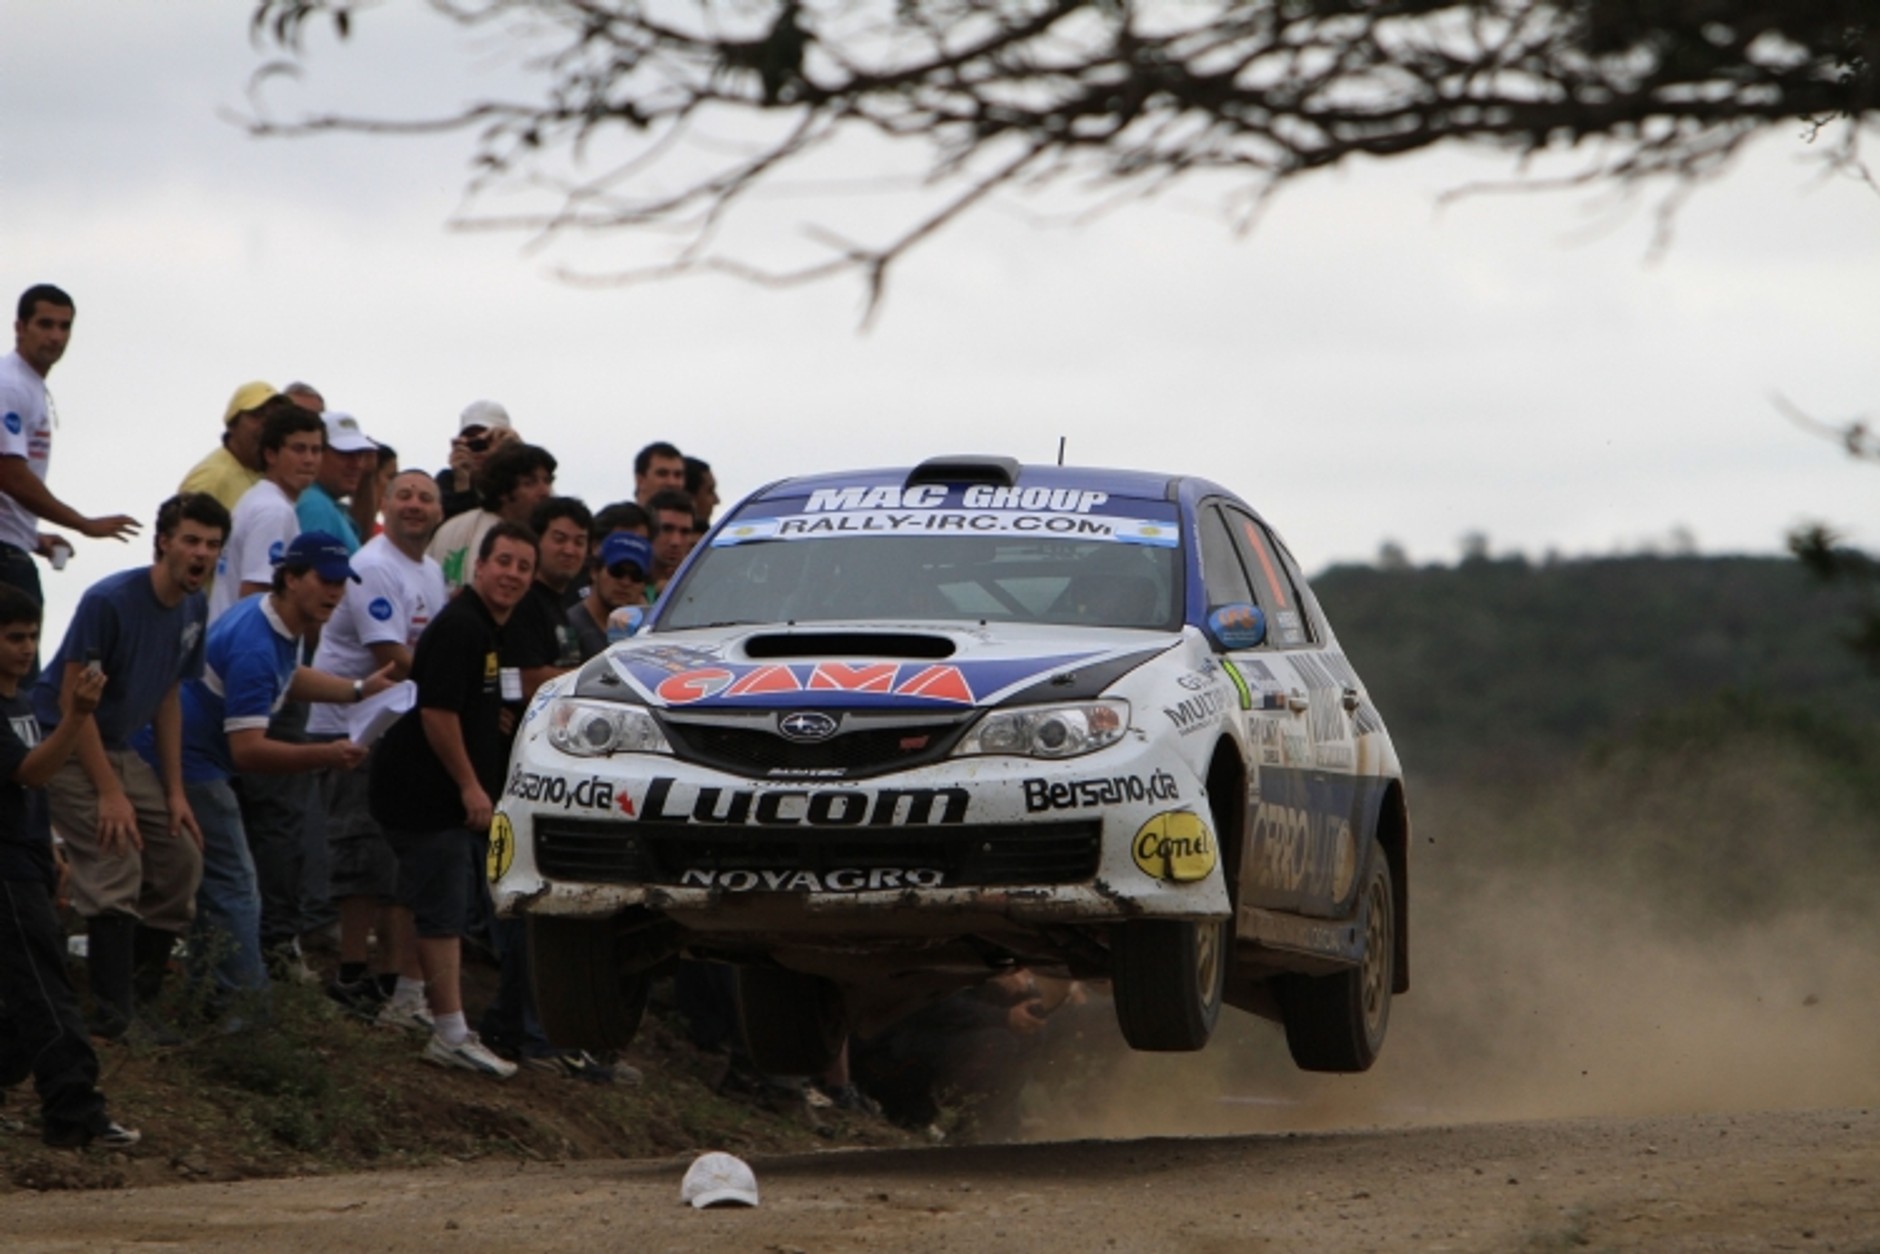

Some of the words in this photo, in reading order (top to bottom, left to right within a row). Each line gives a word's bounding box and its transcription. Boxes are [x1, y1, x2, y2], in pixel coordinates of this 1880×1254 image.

[803, 485, 949, 512] MAC
[962, 484, 1109, 513] GROUP
[779, 514, 1112, 535] RALLY-IRC.COM
[656, 662, 977, 705] GAMA
[680, 868, 944, 892] NOVAGRO
